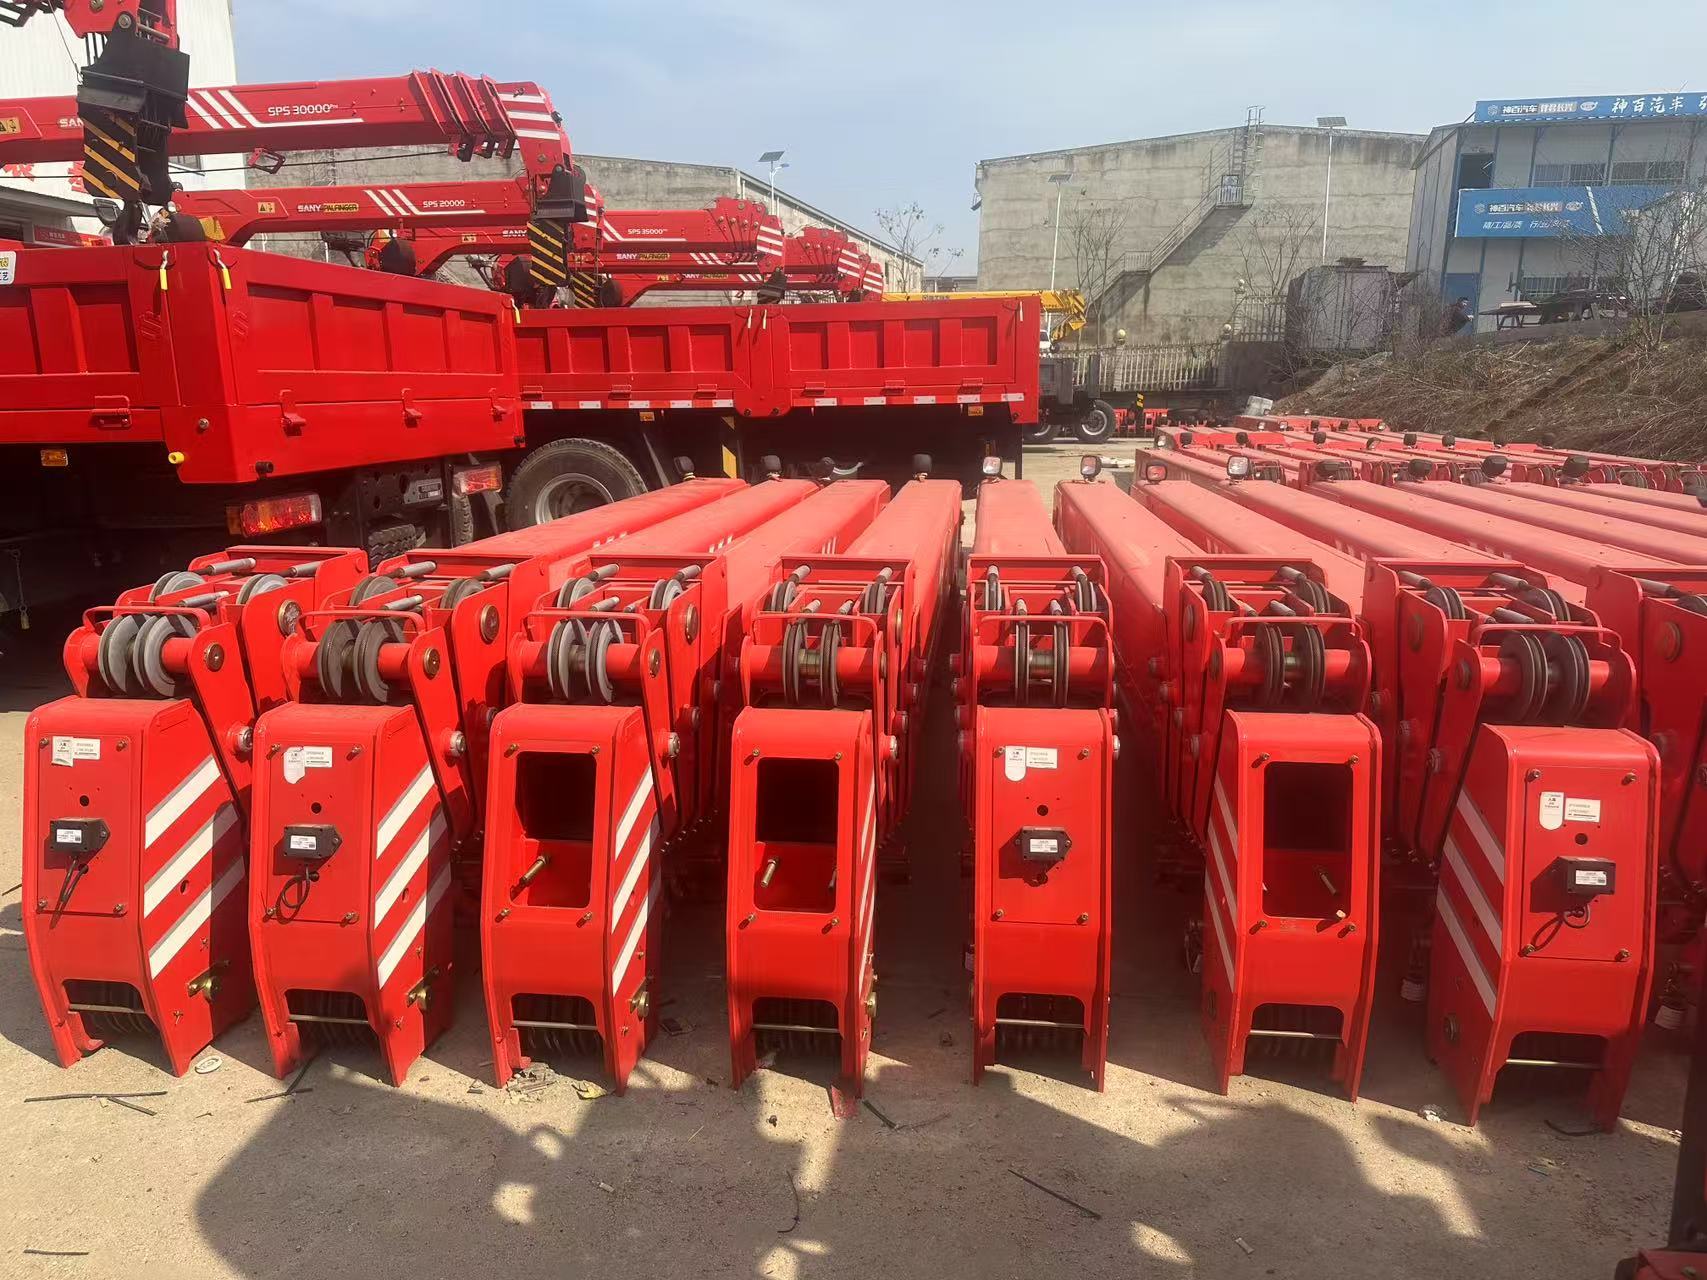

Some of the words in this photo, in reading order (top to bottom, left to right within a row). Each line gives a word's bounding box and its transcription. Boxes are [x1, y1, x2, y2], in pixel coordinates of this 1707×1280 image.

[1611, 96, 1684, 114] 神百汽车
[267, 106, 291, 117] SPS
[59, 117, 85, 128] SAN
[297, 204, 321, 213] SANY
[422, 200, 438, 208] SPS
[439, 199, 466, 208] 20000
